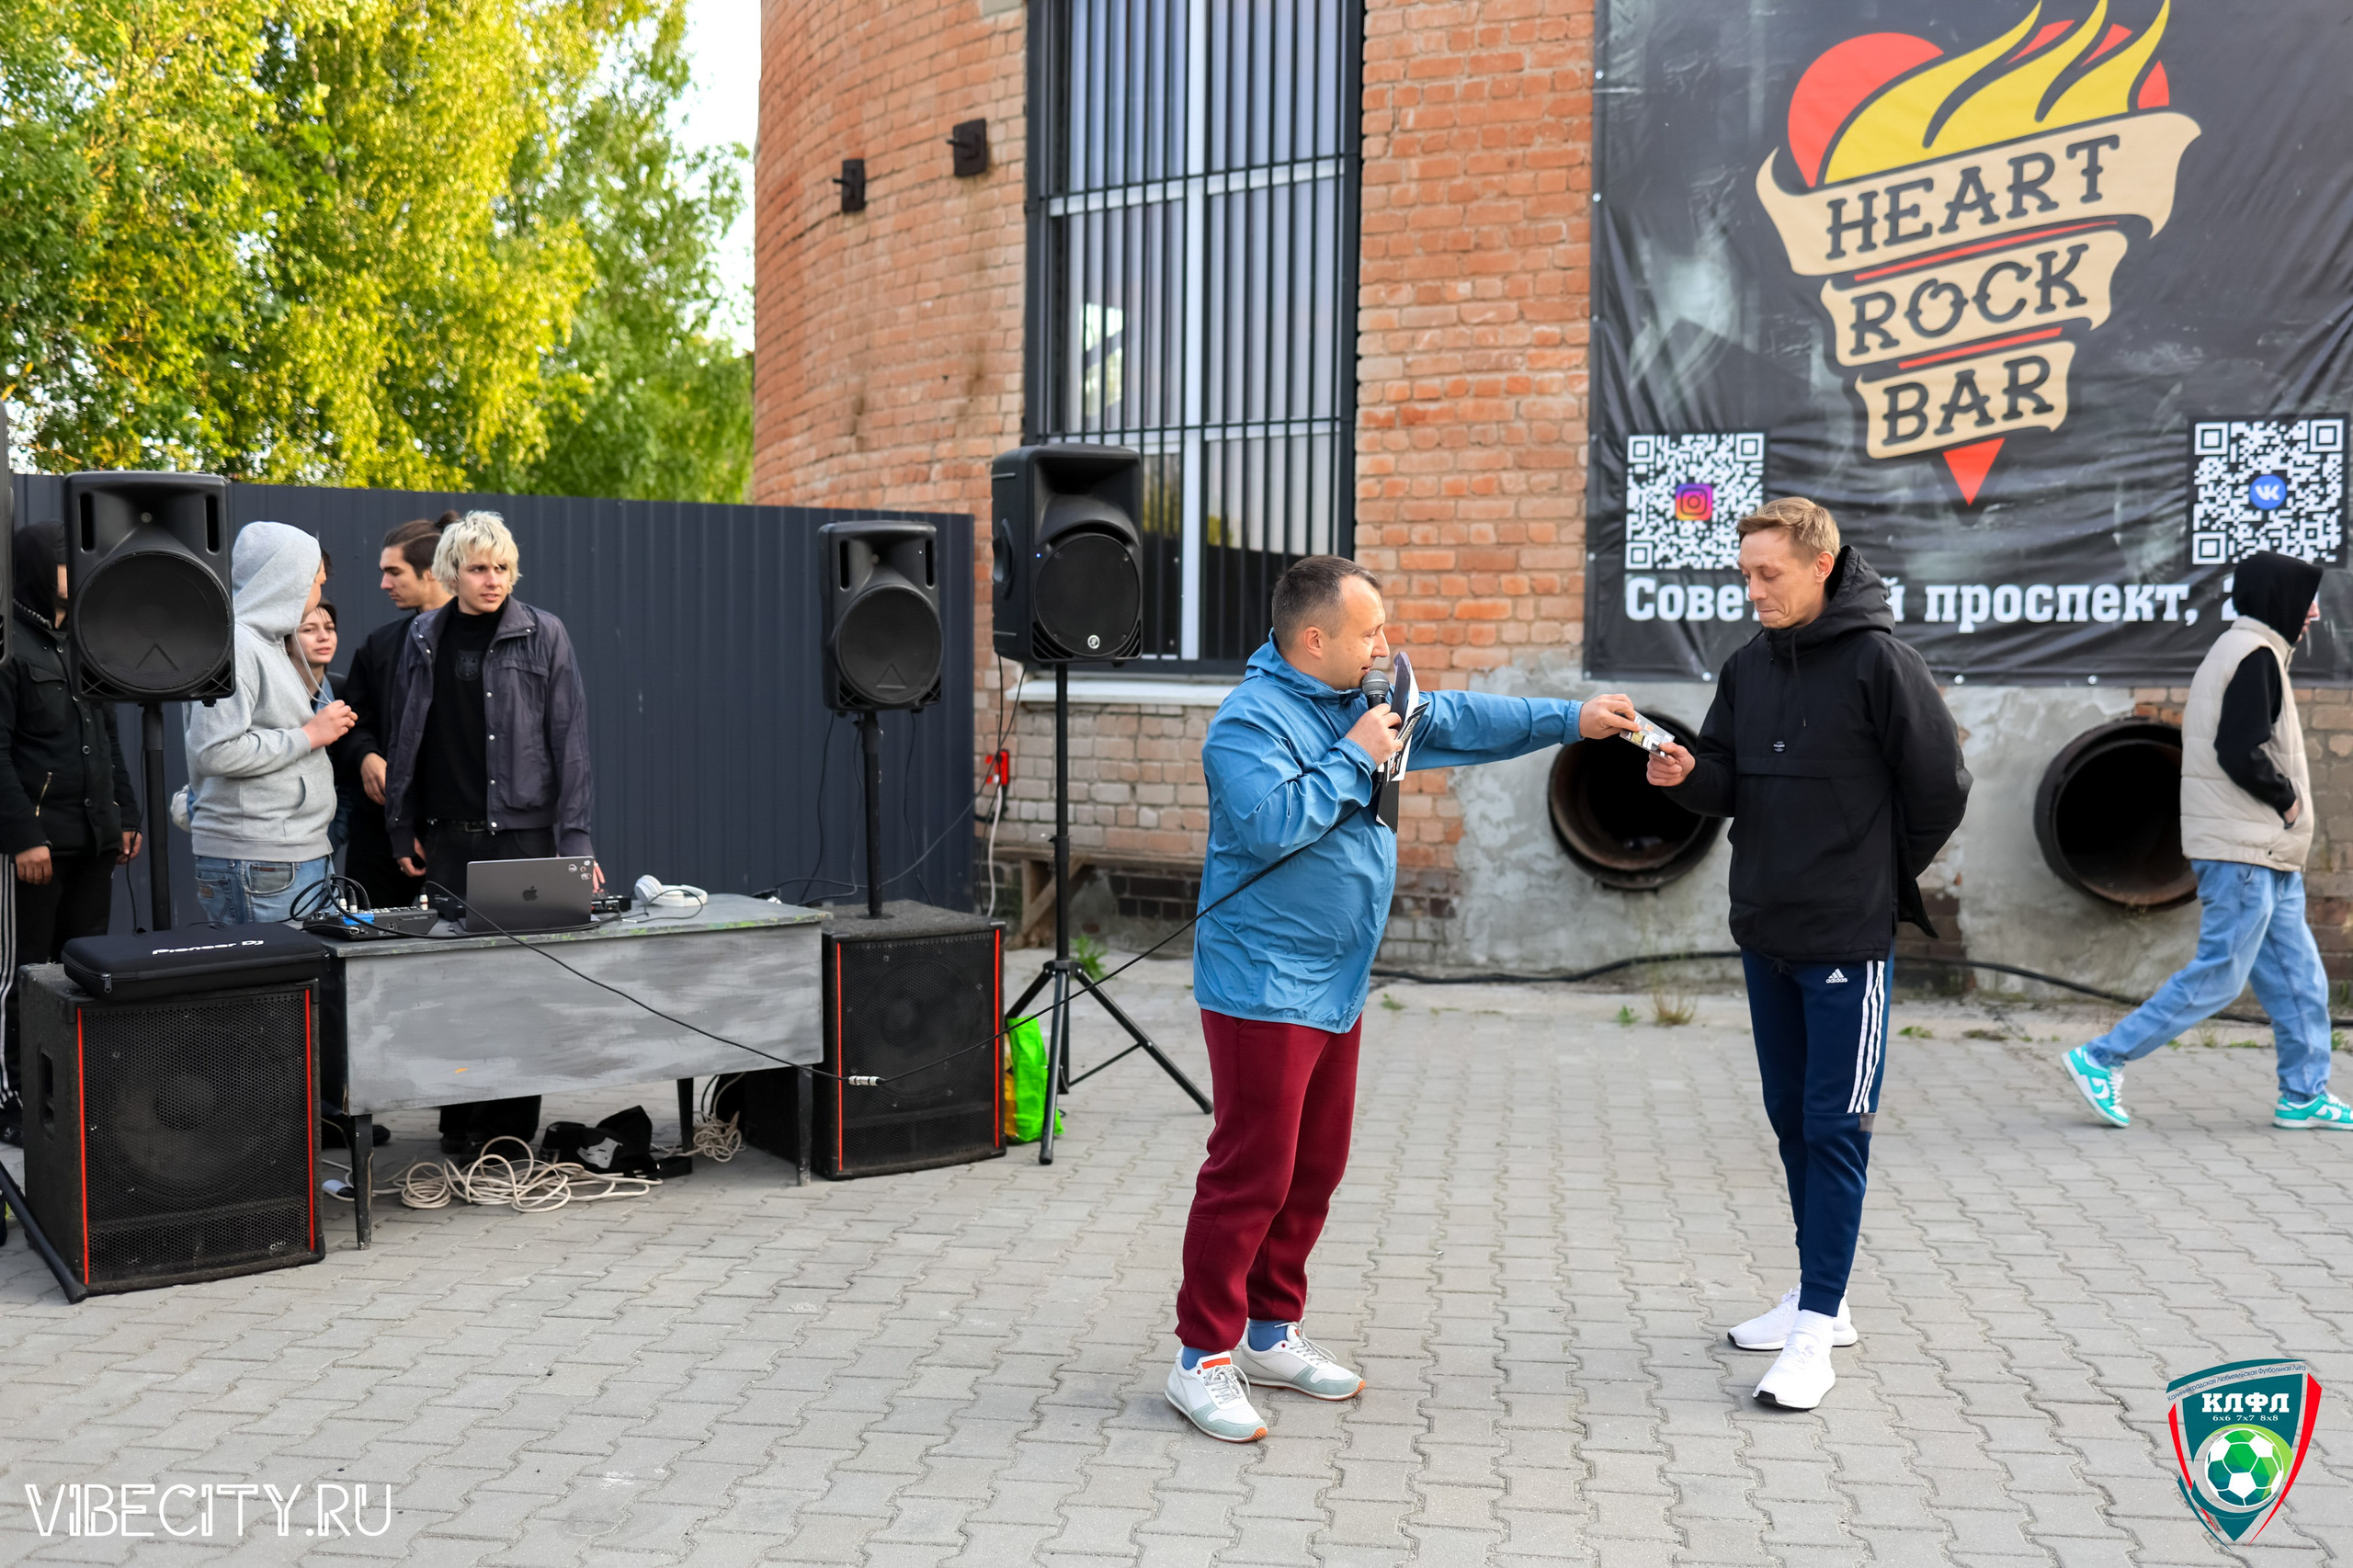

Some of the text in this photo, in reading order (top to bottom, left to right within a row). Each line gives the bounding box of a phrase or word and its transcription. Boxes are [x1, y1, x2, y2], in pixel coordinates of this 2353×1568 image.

[1825, 134, 2120, 260] HEART
[1850, 244, 2088, 356] ROCK
[1881, 356, 2055, 447] BAR
[1625, 577, 1905, 622] Совей
[1925, 583, 2199, 632] проспект,
[152, 943, 236, 955] Pioneer
